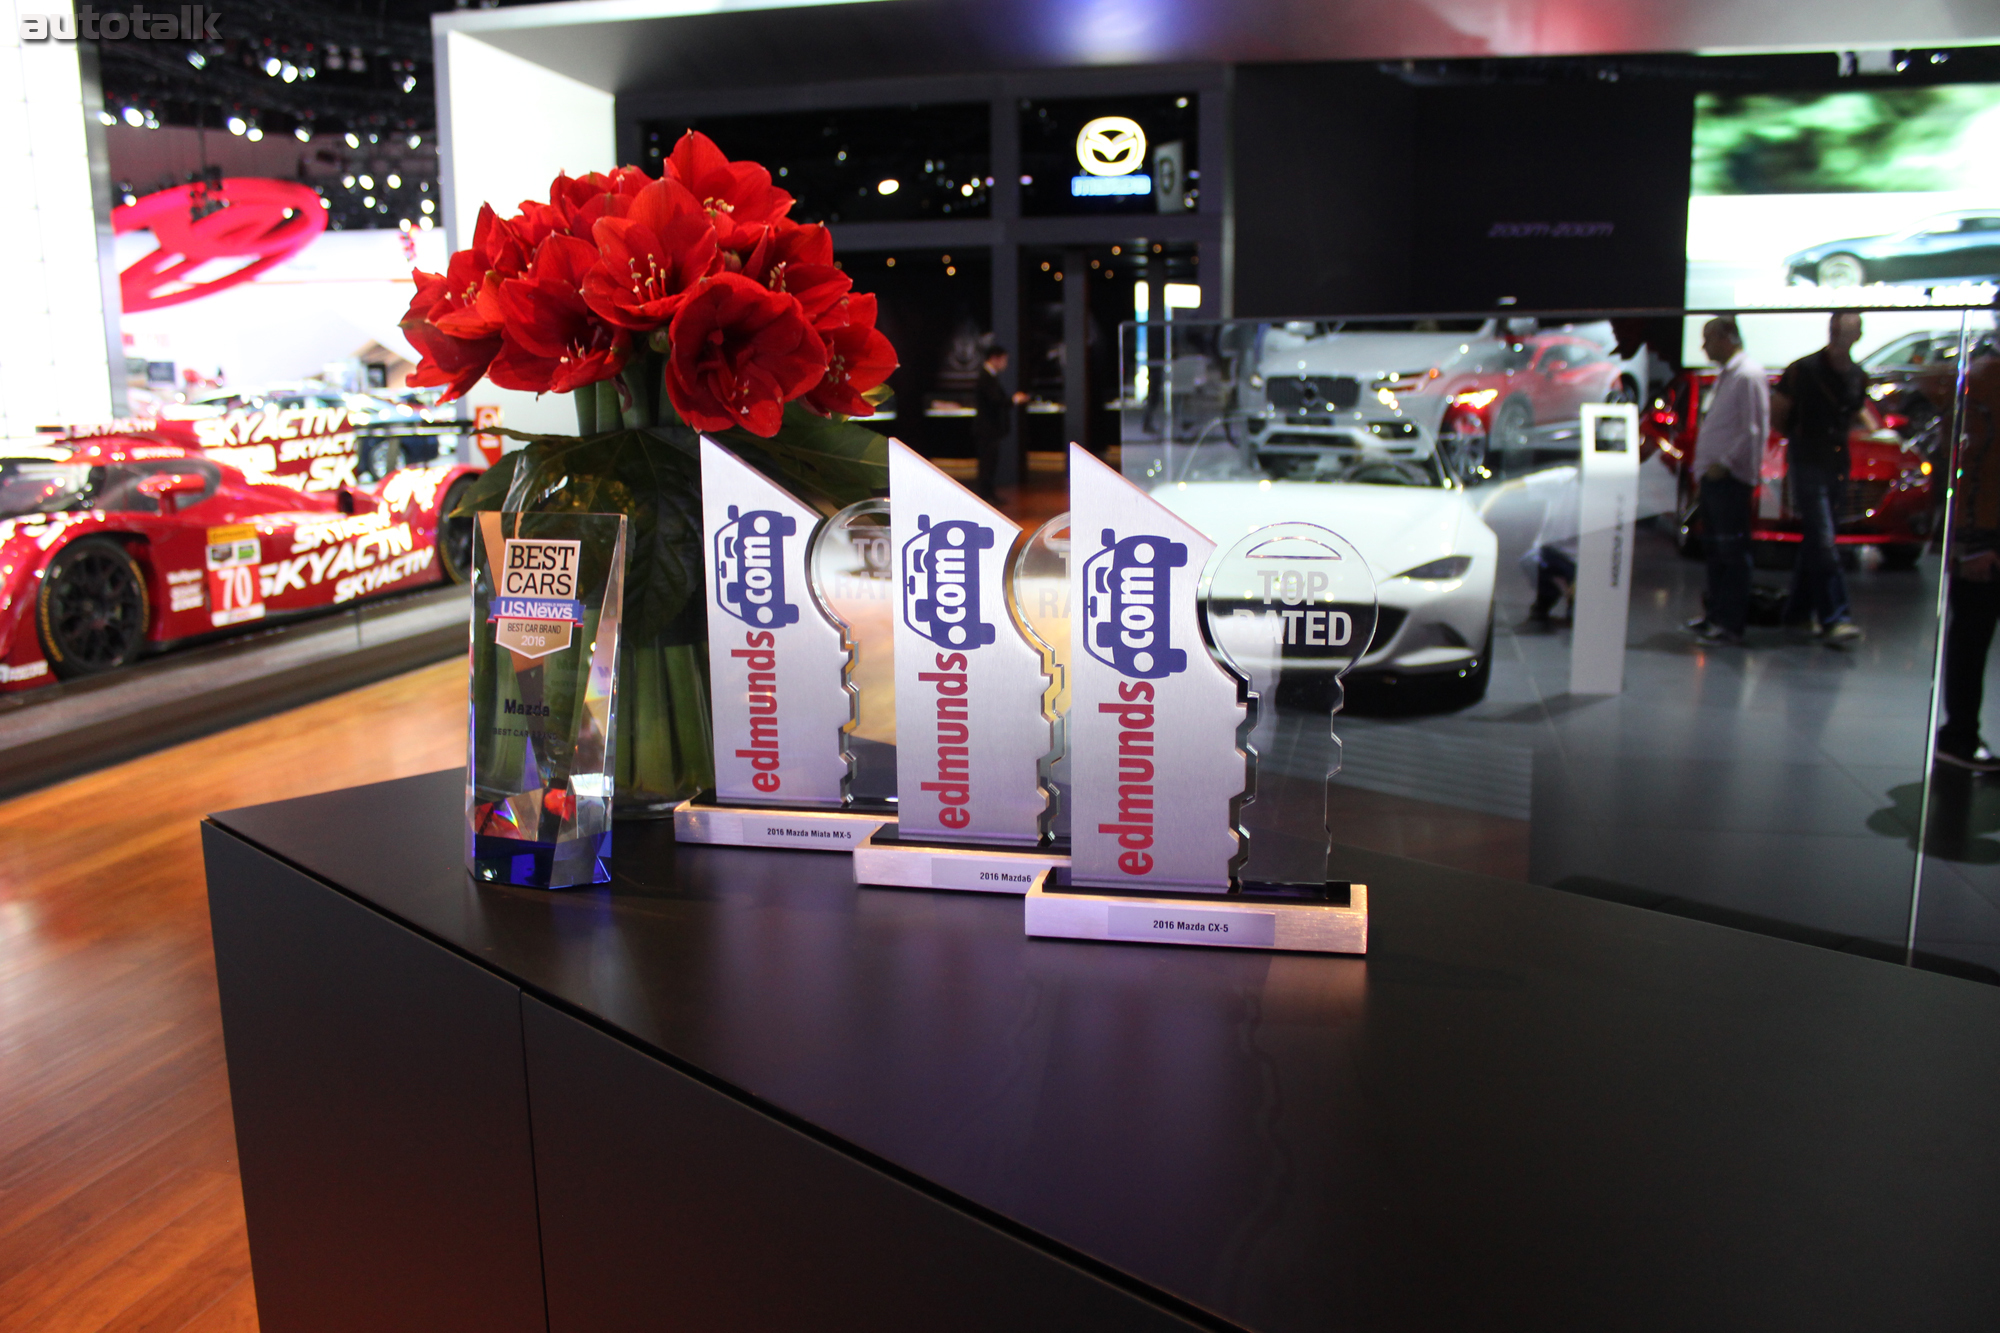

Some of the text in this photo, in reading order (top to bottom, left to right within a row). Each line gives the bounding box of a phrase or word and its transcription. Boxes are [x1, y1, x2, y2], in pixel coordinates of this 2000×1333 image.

[193, 408, 347, 447] SKYACTIV
[508, 545, 575, 571] BEST
[852, 537, 891, 568] TO
[333, 545, 434, 604] SKYACTIV
[506, 572, 572, 595] CARS
[835, 571, 891, 600] RAT
[217, 565, 253, 611] 70
[1257, 570, 1329, 606] TOP
[507, 623, 561, 634] BEST CAR BRAND
[521, 635, 546, 647] 2016
[504, 698, 550, 717] Mazda
[513, 729, 529, 737] CAR
[767, 828, 852, 839] 2016 Mazda Miata MX-5
[980, 872, 1032, 883] 2016 Mazda6
[1153, 920, 1229, 933] 2016 Mazda CX-5
